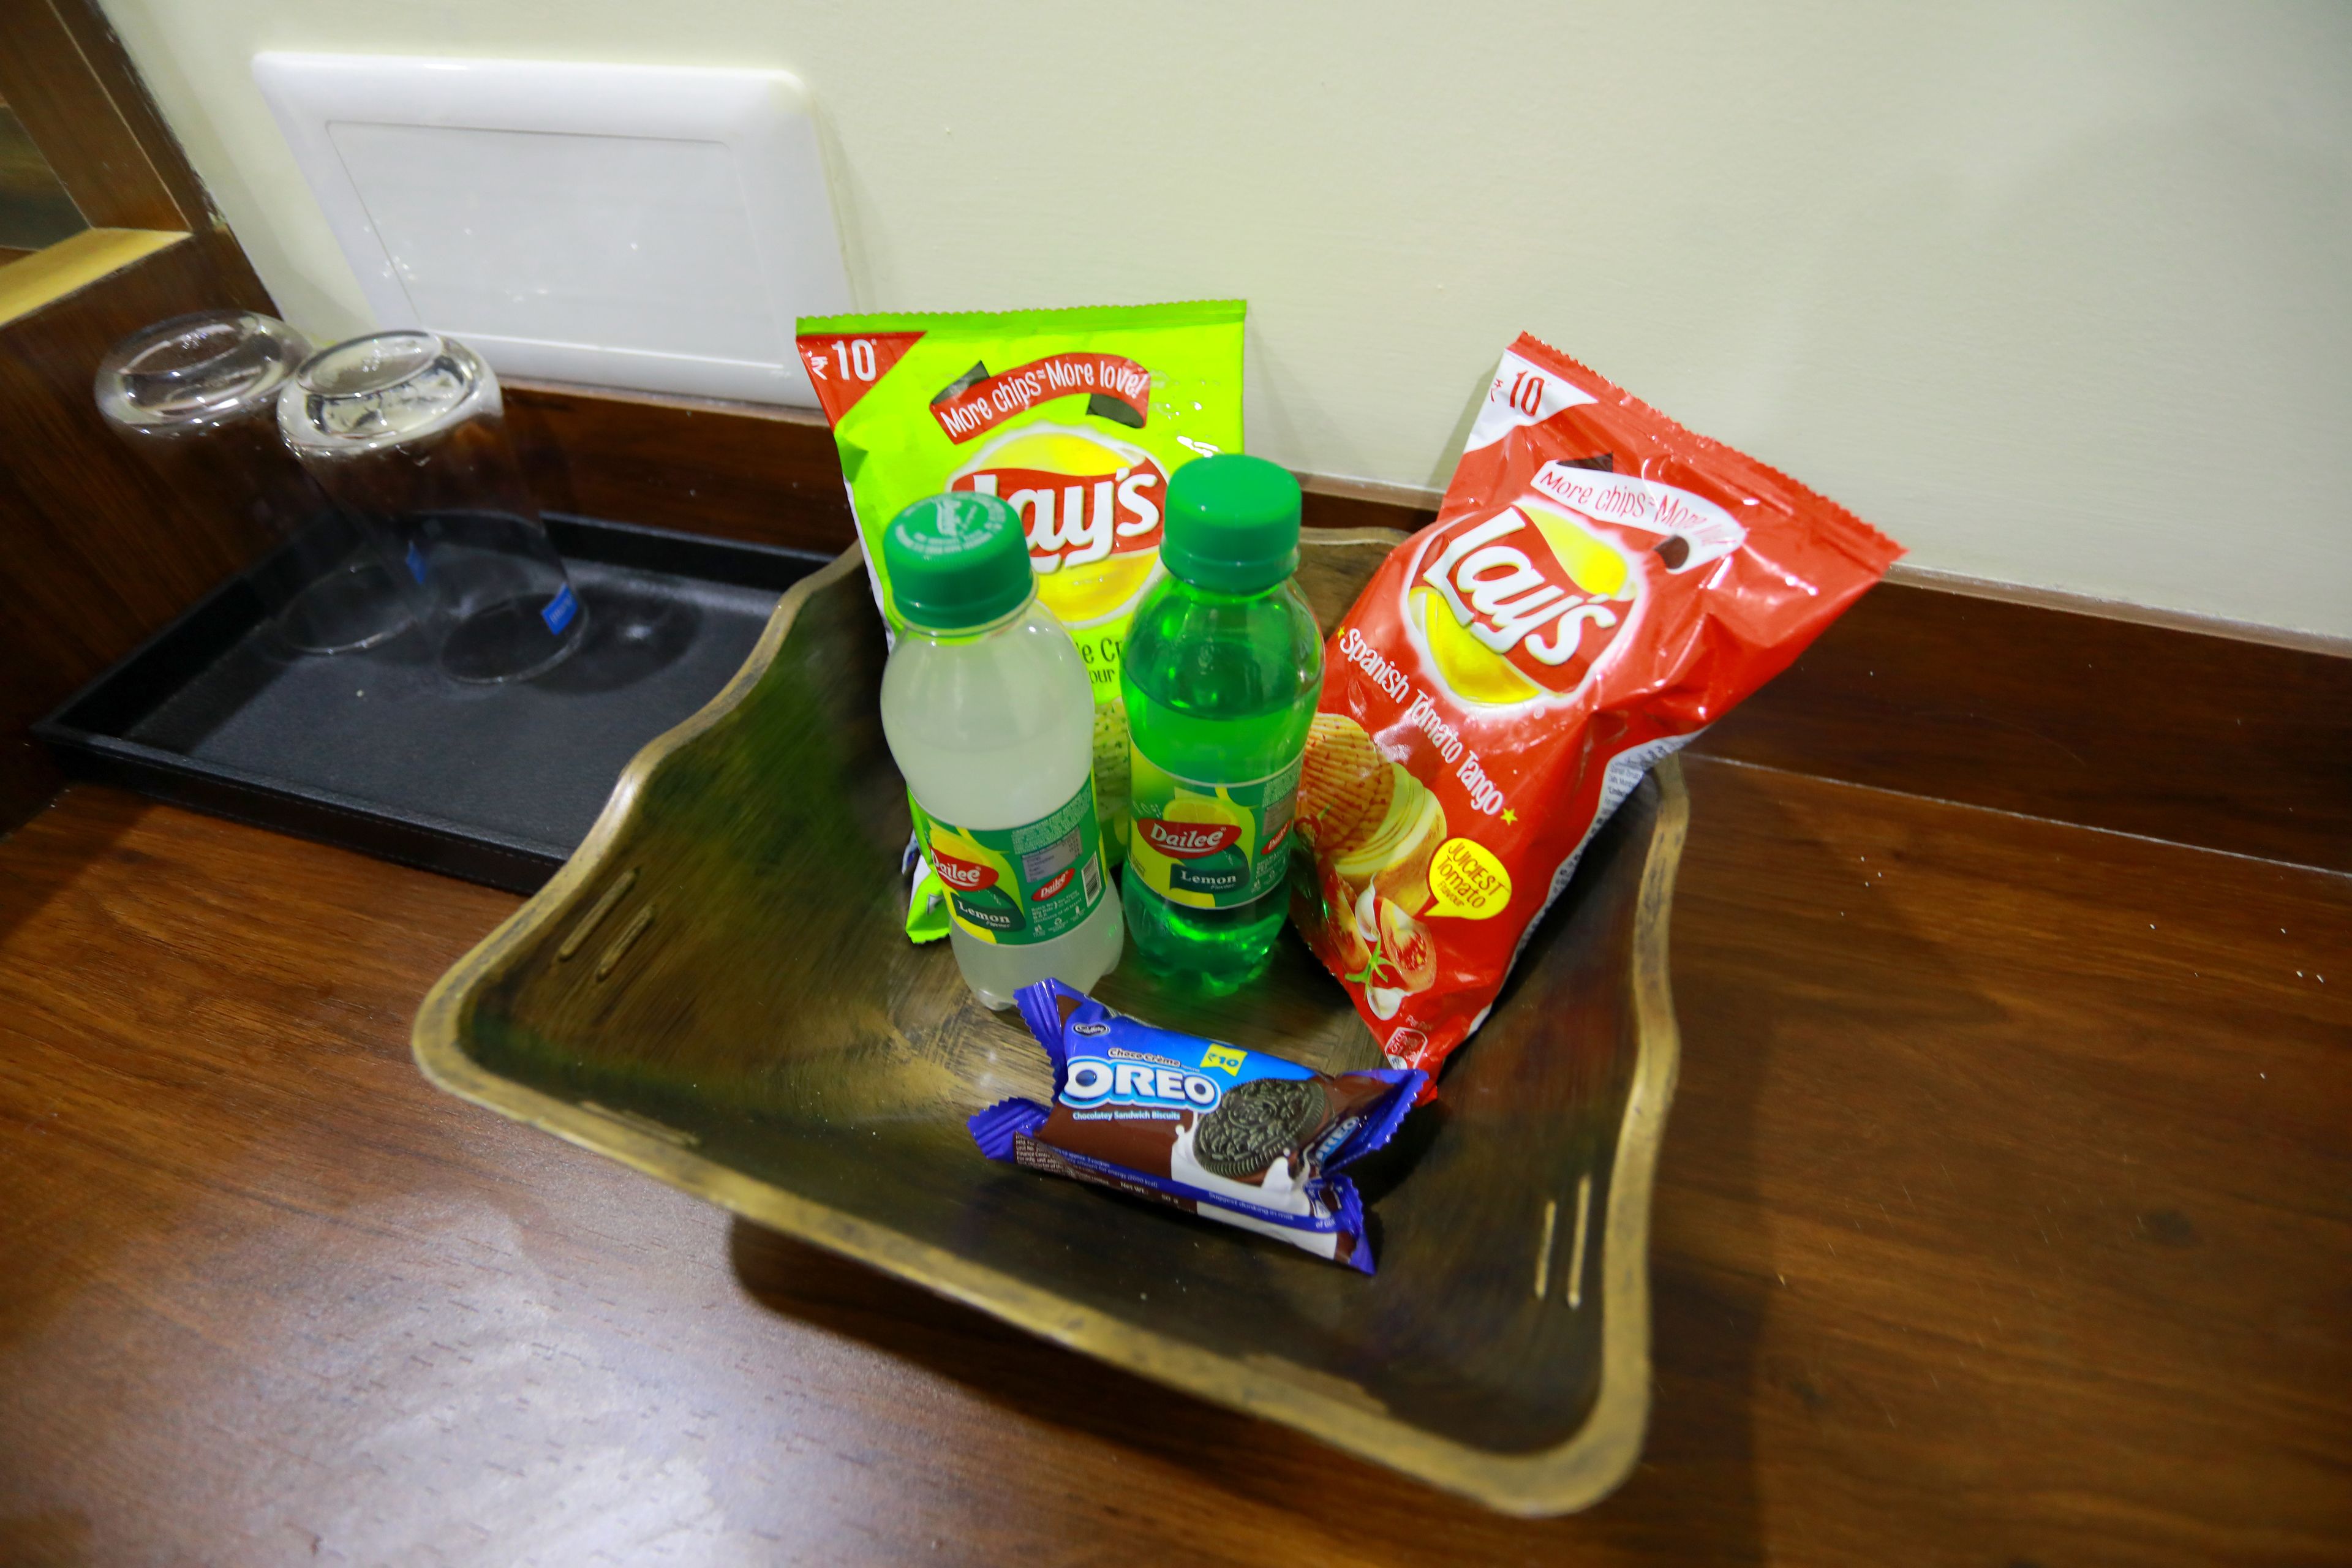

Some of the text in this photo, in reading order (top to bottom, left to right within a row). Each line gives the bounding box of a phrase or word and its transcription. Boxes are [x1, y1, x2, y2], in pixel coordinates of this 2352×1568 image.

[940, 394, 993, 437] More
[1099, 360, 1149, 399] love!
[1509, 369, 1545, 417] 10
[1539, 470, 1593, 505] More
[974, 467, 1160, 573] ay's
[1423, 507, 1618, 666] Lay's
[1339, 628, 1504, 816] Spanish Tomato Tango
[1150, 823, 1224, 848] Dailee
[1180, 869, 1237, 885] Lemon
[1437, 854, 1486, 908] Tomato
[1449, 842, 1511, 896] JUICIEST
[957, 899, 1011, 924] Lemon
[1110, 1048, 1143, 1060] Choco
[1066, 1060, 1216, 1105] OREO
[1072, 1110, 1181, 1121] Chocolatey Sandwich Biscuits
